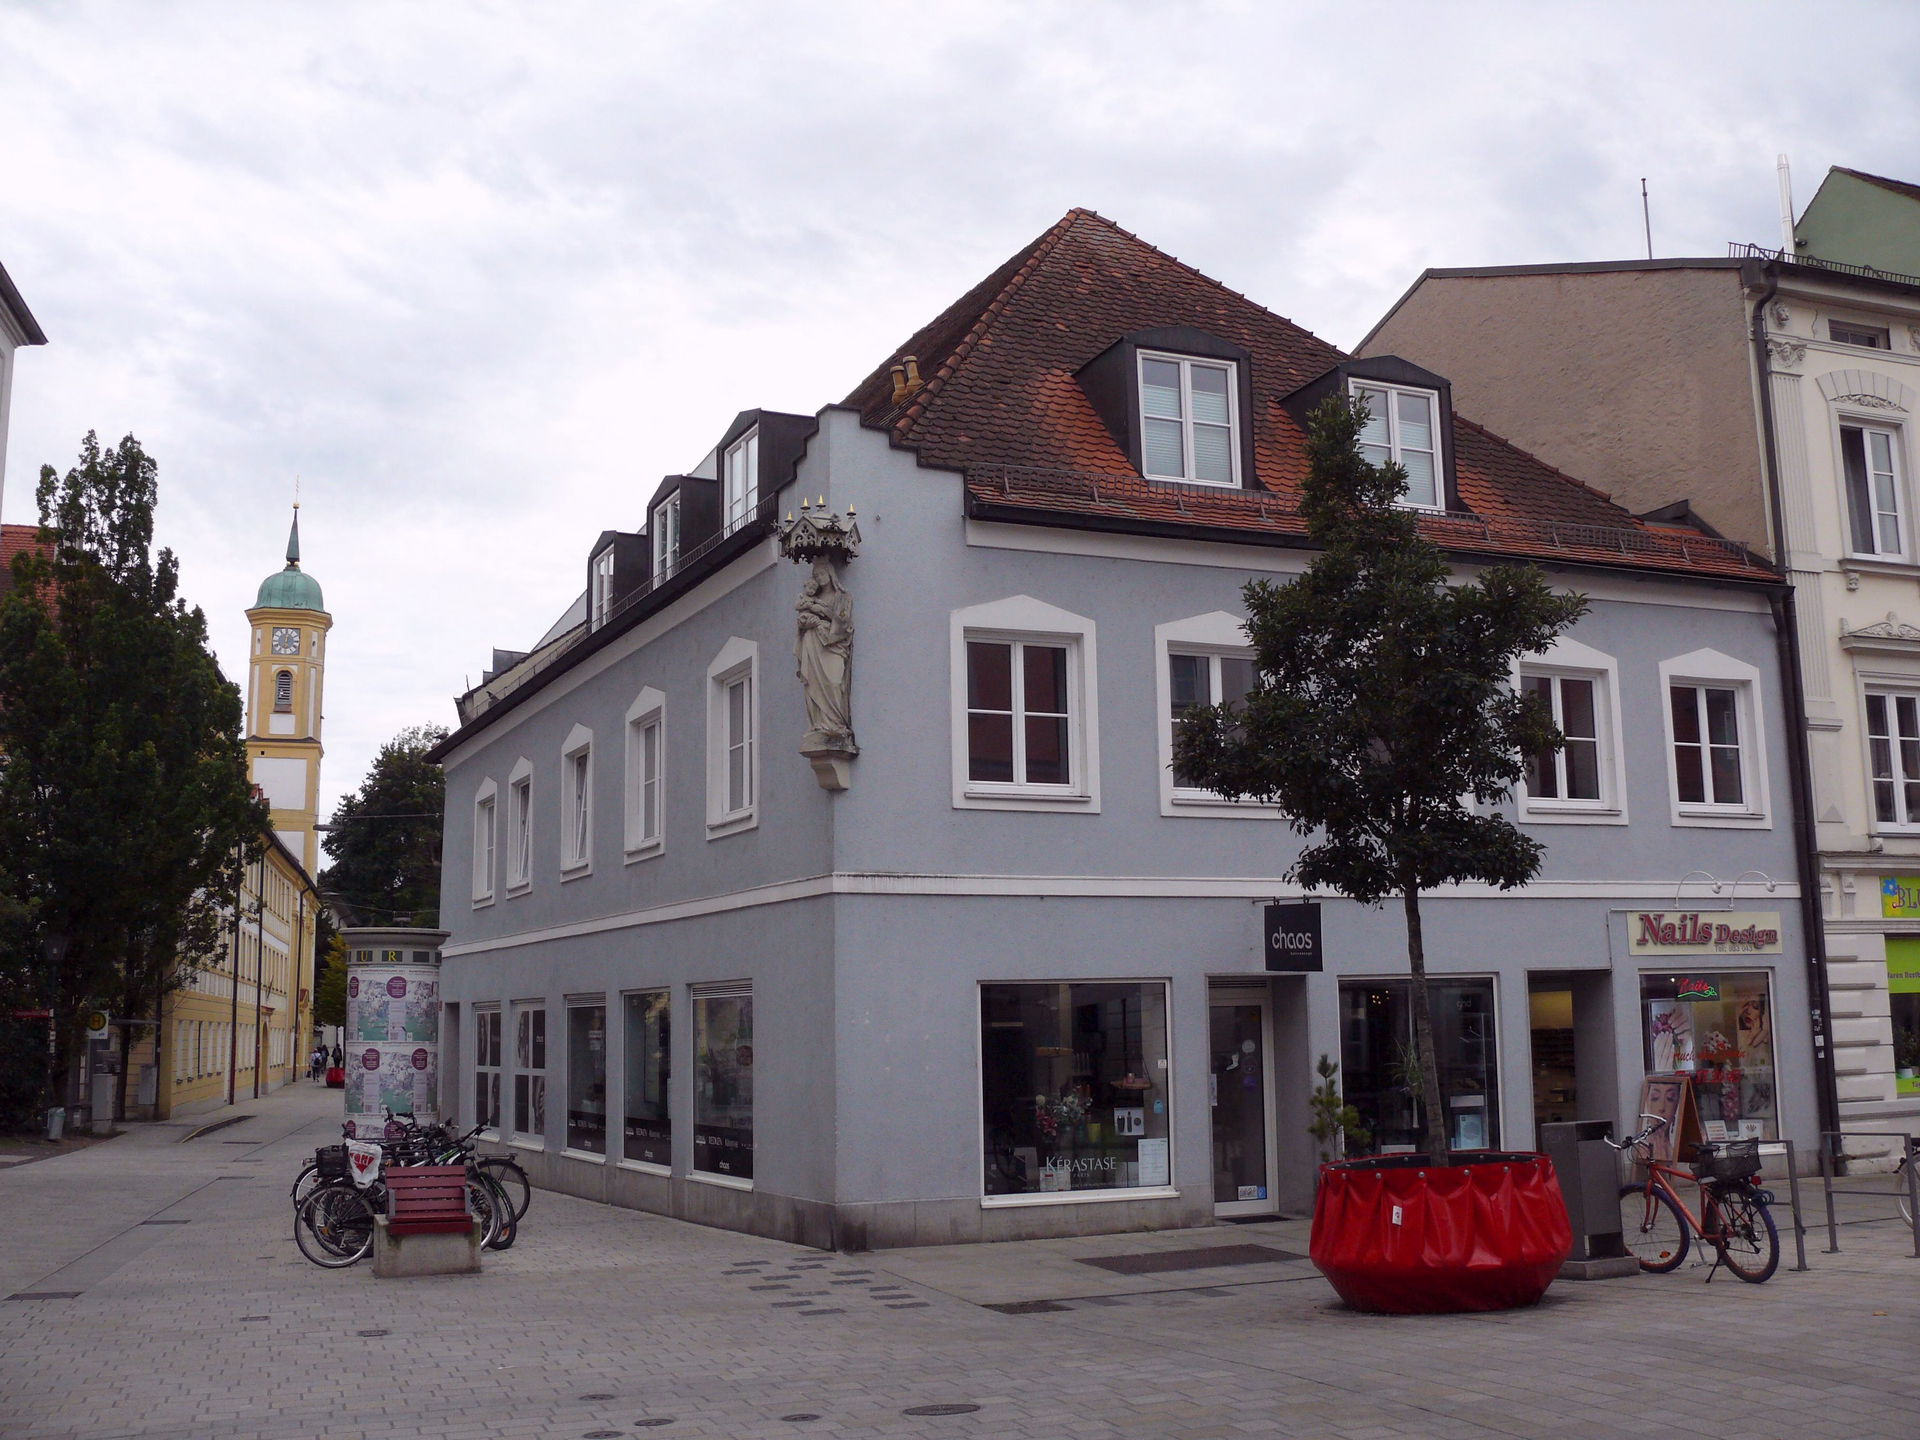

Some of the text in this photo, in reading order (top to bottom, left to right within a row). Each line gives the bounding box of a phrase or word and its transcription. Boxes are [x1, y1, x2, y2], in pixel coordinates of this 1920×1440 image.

[1272, 926, 1312, 949] chaos
[1637, 913, 1778, 949] Nails Design
[1046, 1156, 1117, 1172] KÉRASTASE
